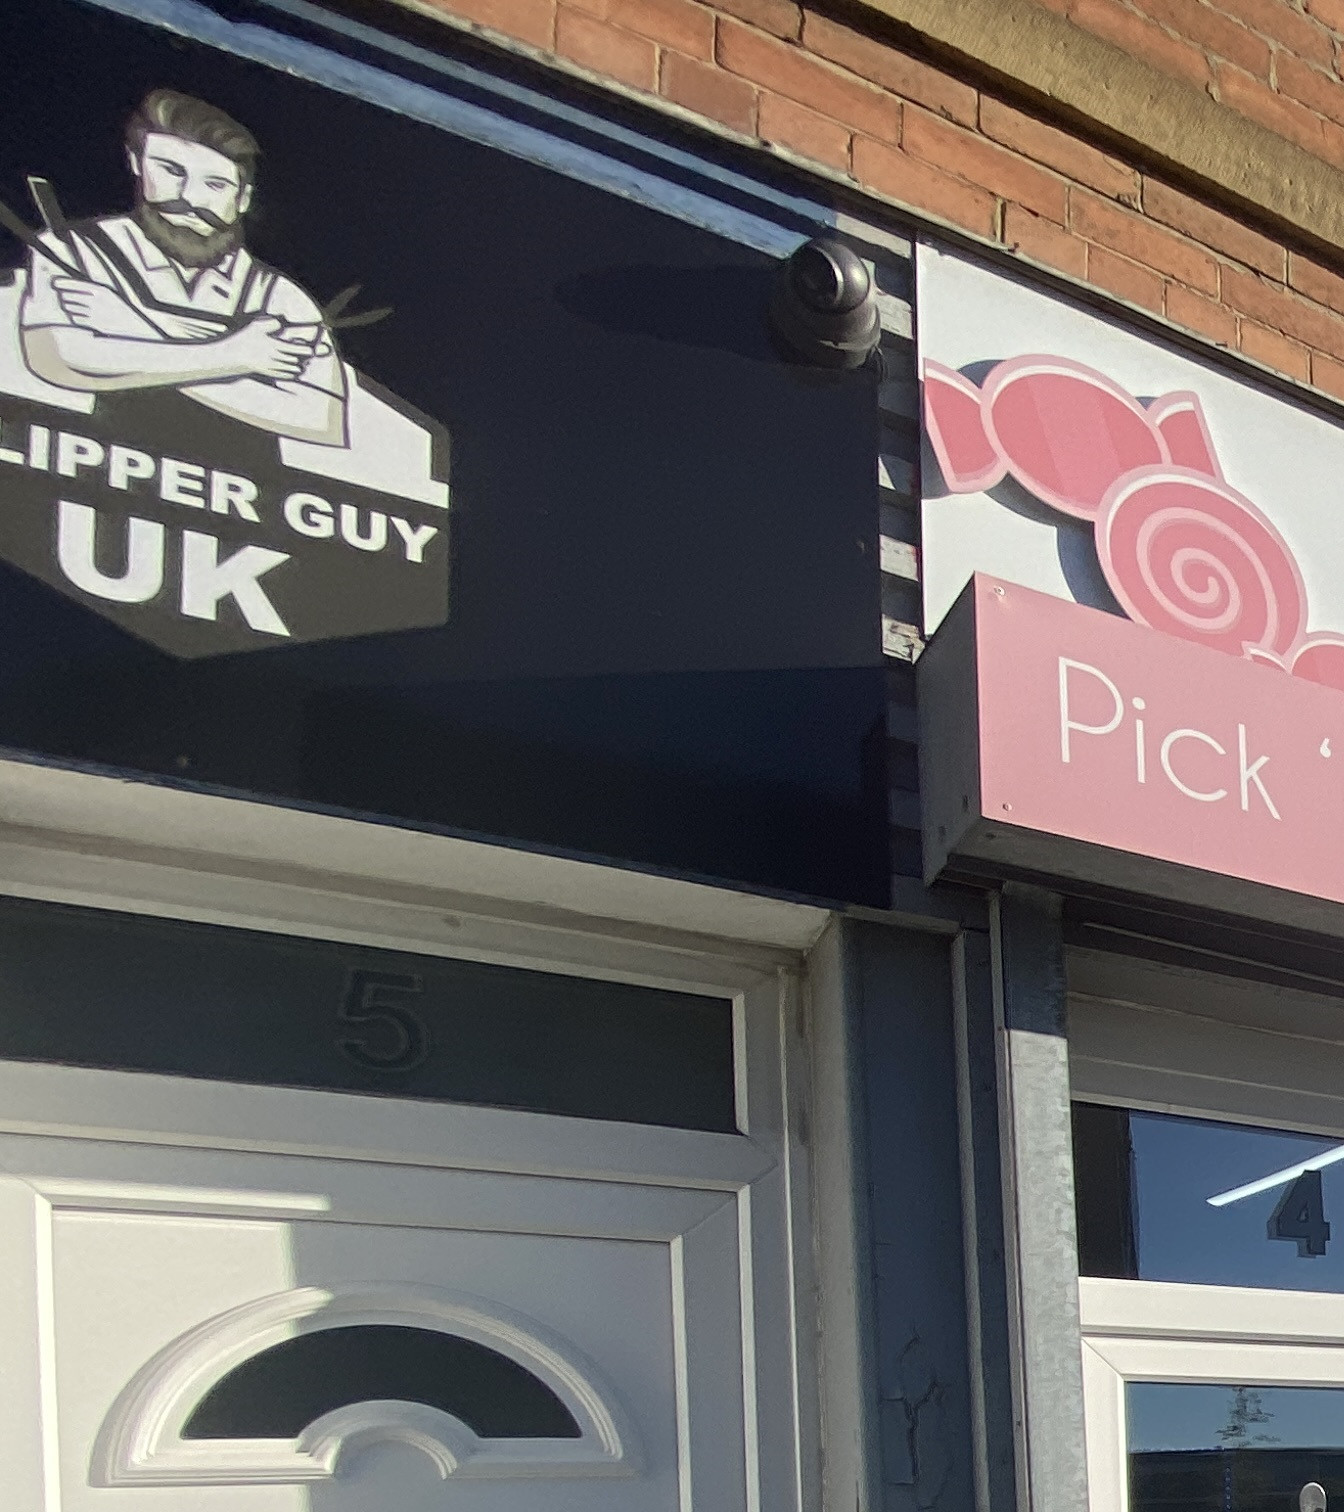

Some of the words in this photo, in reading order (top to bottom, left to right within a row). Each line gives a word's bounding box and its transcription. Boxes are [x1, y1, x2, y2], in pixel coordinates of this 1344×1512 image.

[57, 500, 291, 638] UK
[283, 492, 439, 564] GUY
[1057, 656, 1281, 820] Pick
